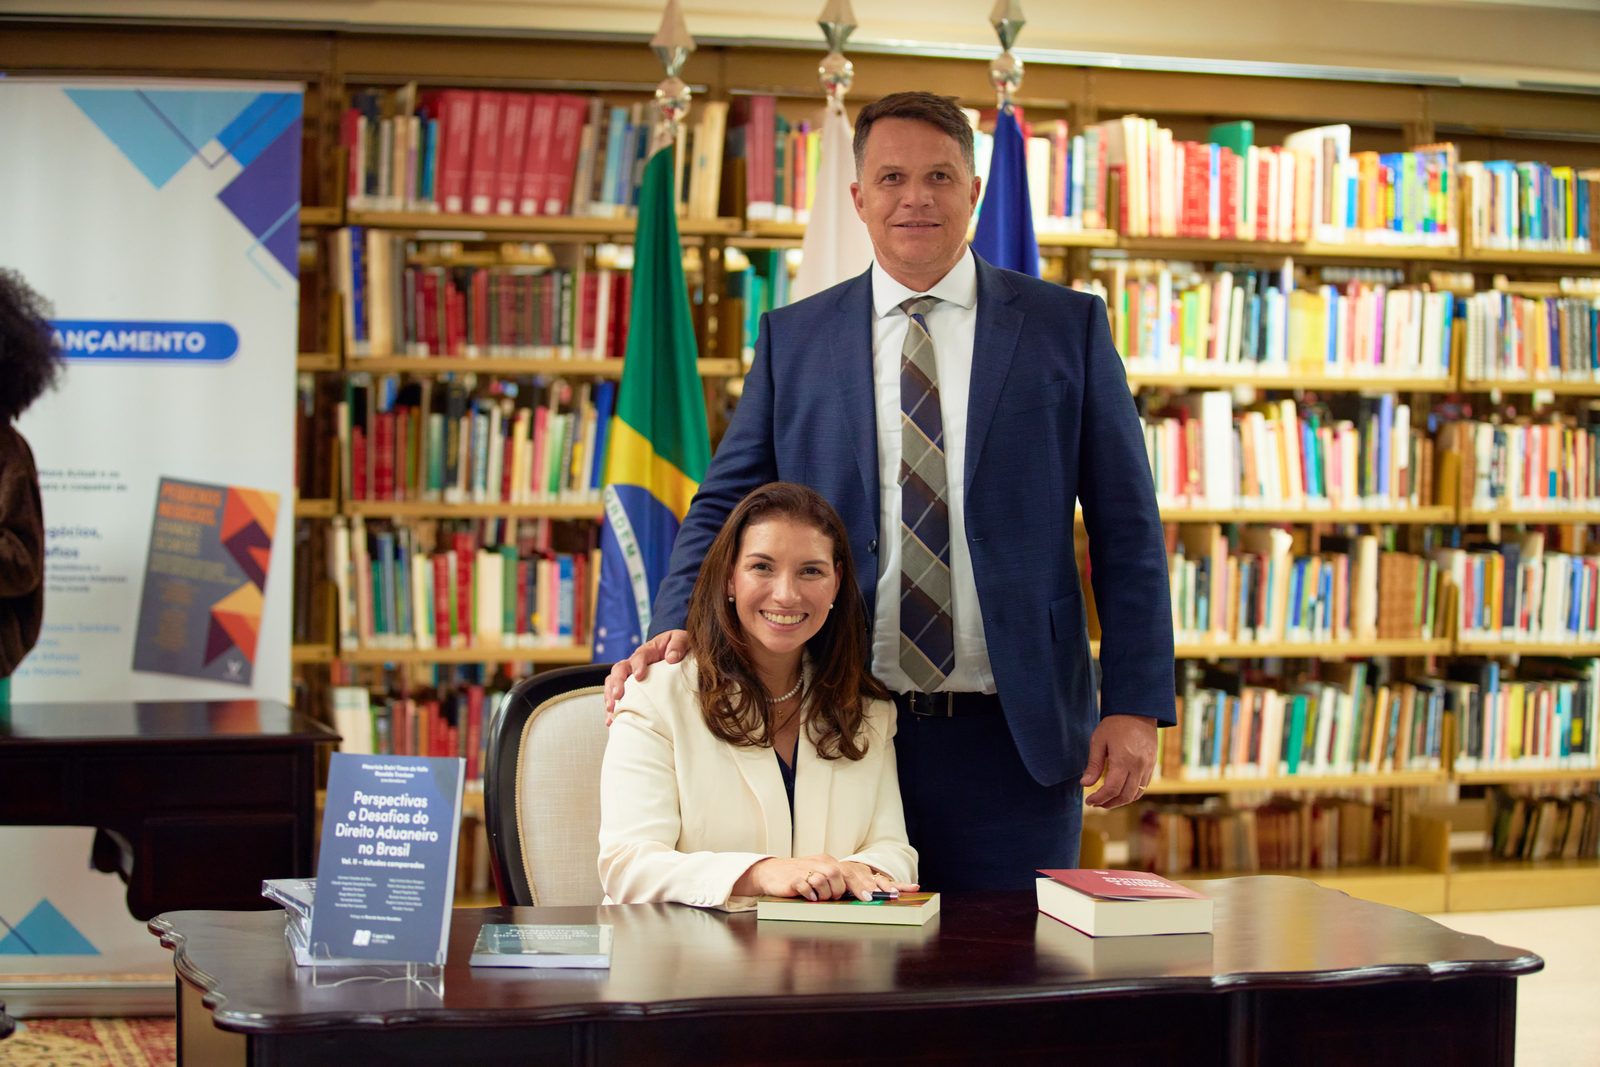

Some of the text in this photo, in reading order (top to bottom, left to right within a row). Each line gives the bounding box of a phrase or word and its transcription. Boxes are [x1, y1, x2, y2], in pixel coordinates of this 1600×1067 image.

[51, 330, 206, 354] ANÇAMENTO
[44, 525, 103, 540] gócios,
[604, 490, 637, 557] ORDEM
[44, 545, 80, 559] afios
[353, 790, 428, 809] Perspectivas
[348, 807, 429, 825] e Desafios do
[335, 822, 439, 842] Direito Aduaneiro
[358, 841, 411, 857] no Brasil
